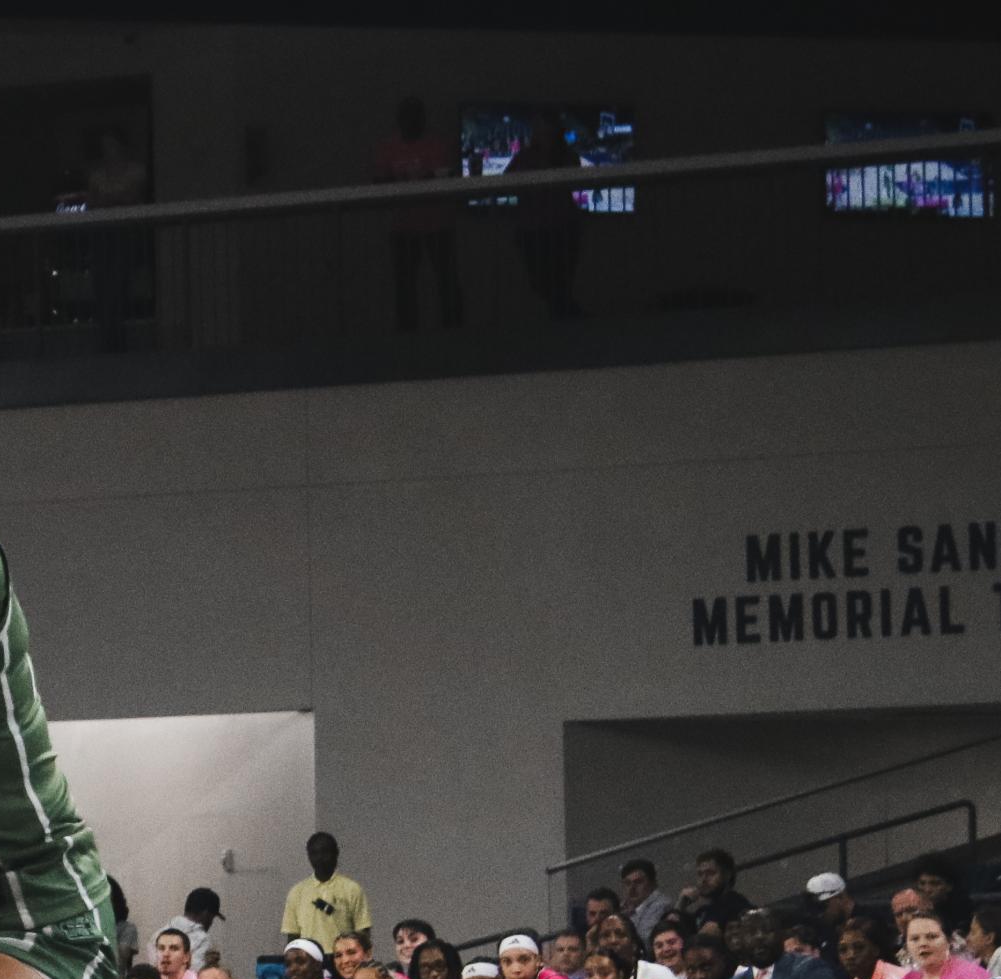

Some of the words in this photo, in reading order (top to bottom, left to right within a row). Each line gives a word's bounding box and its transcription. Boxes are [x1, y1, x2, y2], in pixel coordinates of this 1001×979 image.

[745, 528, 870, 583] MIKE
[897, 521, 997, 574] SAN
[692, 586, 965, 646] MEMORIAL
